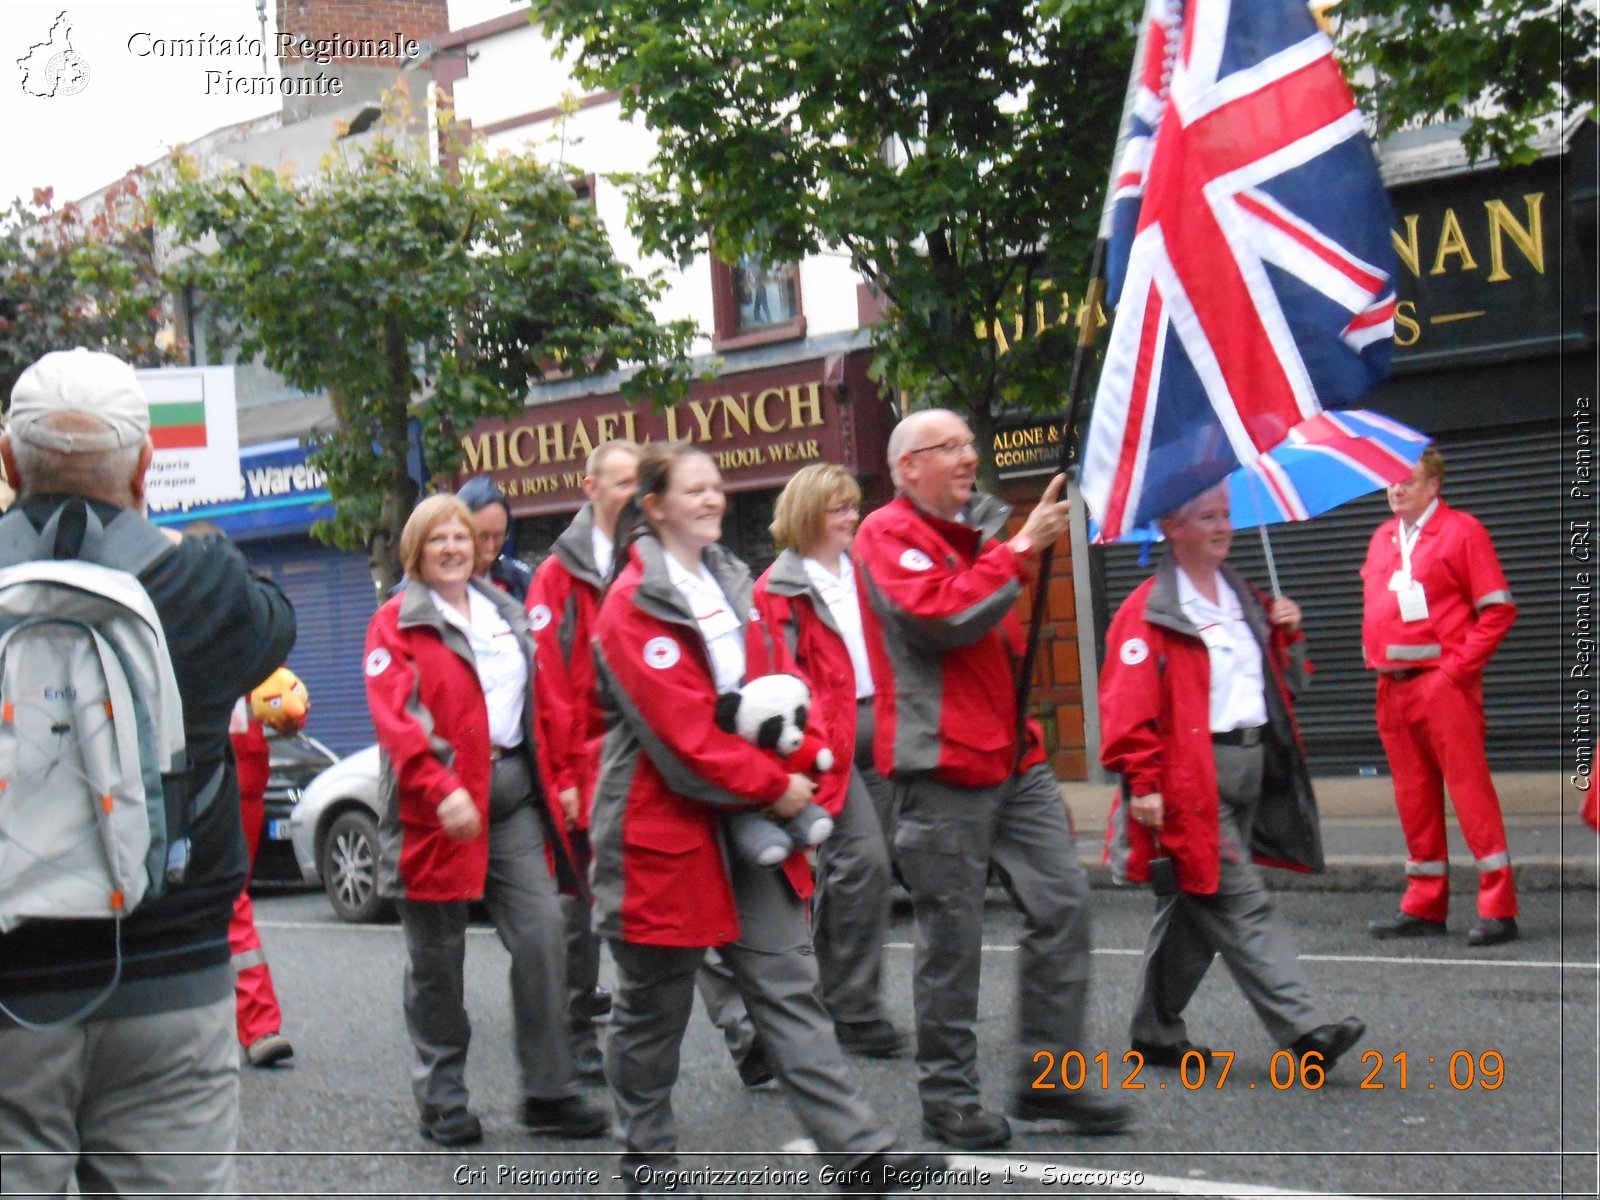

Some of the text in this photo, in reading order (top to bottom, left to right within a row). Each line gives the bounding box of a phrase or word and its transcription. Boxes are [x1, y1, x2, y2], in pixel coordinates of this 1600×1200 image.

[460, 382, 824, 474] MICHAEL LYNCH
[1047, 425, 1058, 443] &
[508, 479, 518, 496] &
[522, 475, 559, 494] BOYS
[714, 448, 766, 470] HOOL
[768, 439, 820, 462] WEAR
